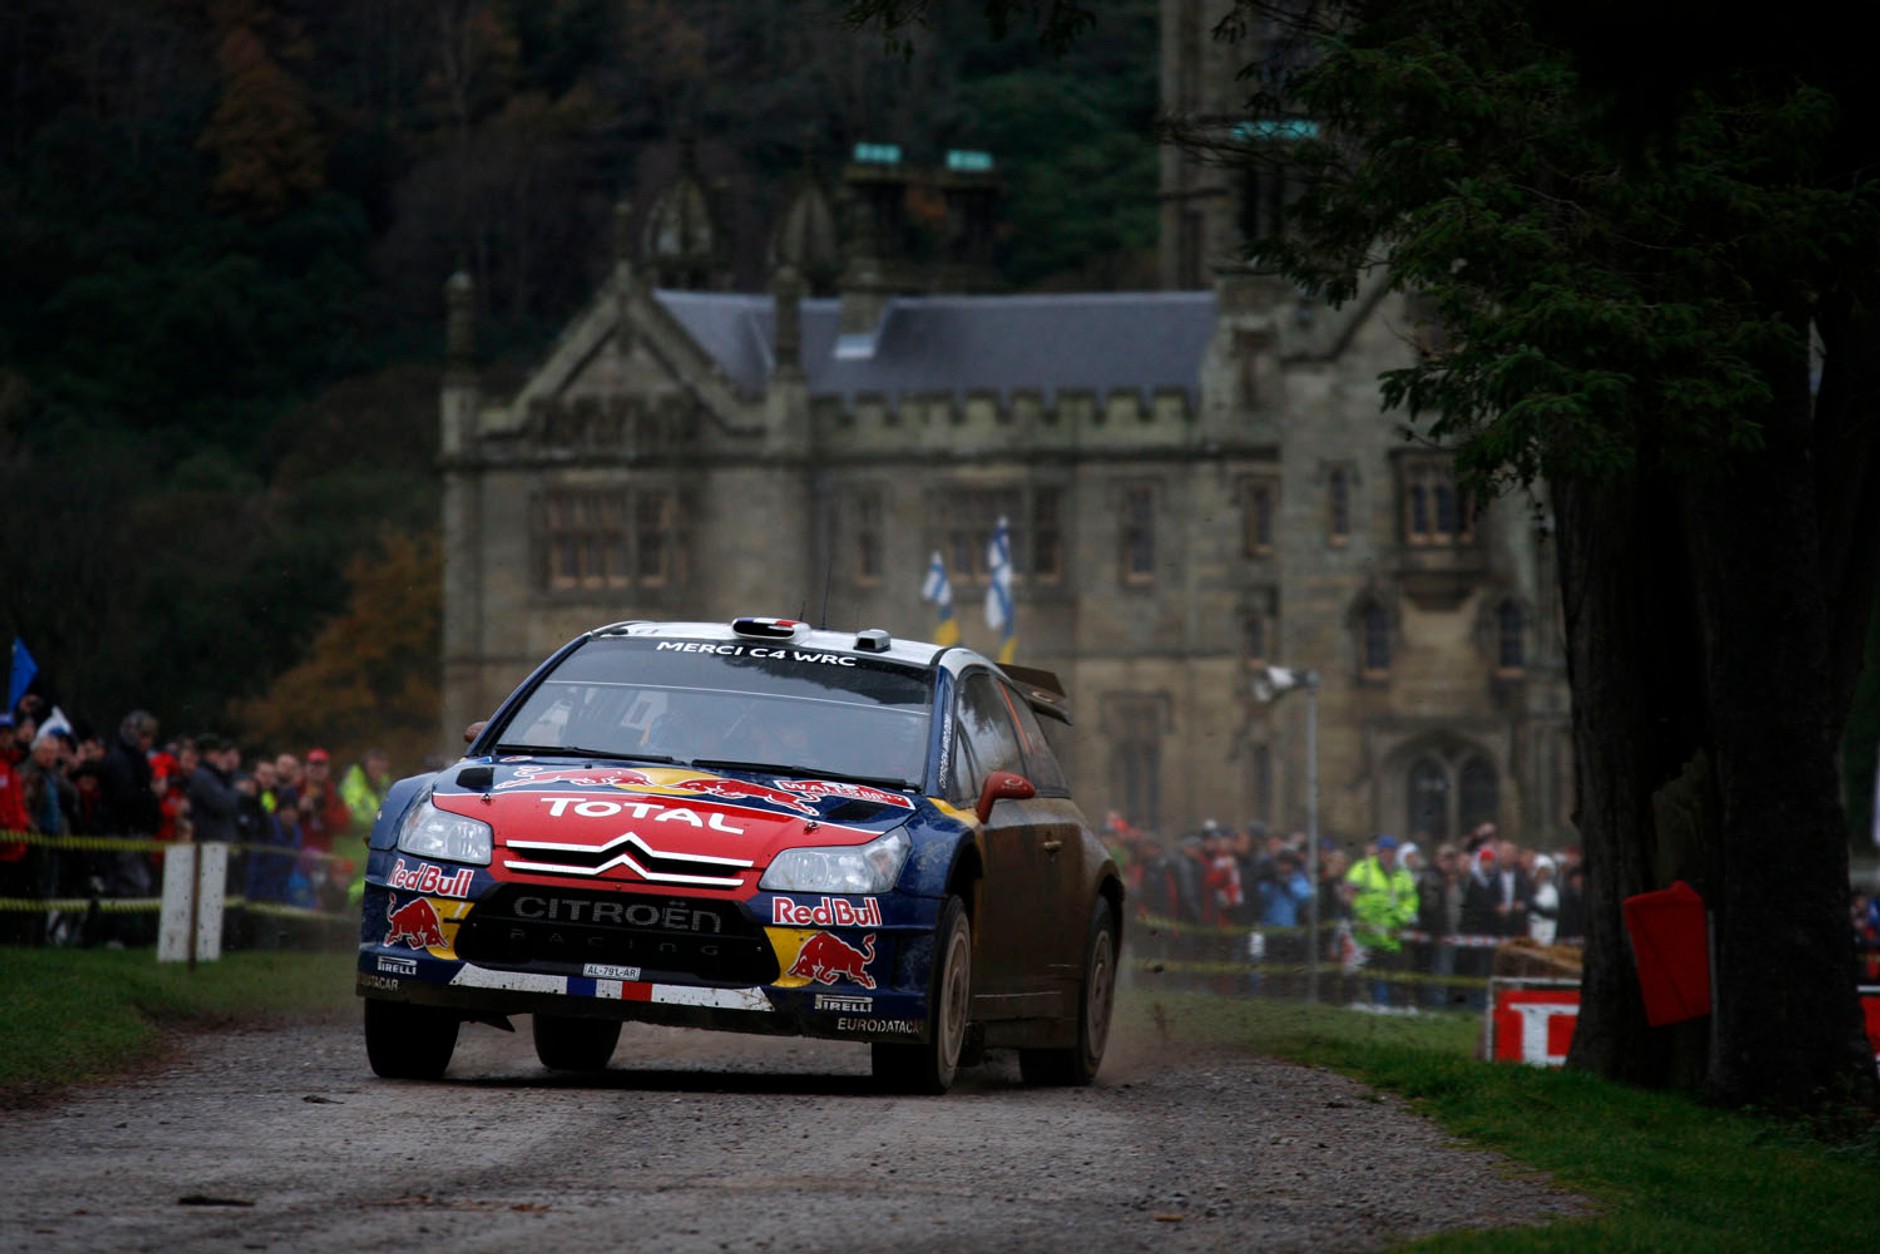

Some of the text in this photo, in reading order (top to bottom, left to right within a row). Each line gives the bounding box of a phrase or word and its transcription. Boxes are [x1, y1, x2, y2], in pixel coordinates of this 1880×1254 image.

[656, 641, 857, 666] MERCI C4 WRC
[541, 797, 744, 835] TOTAL
[387, 859, 474, 898] Red Bull
[772, 896, 882, 926] Red Bull
[377, 955, 418, 976] PIRELLI
[587, 964, 637, 979] AL-791-AR
[814, 993, 873, 1013] PIRELLI
